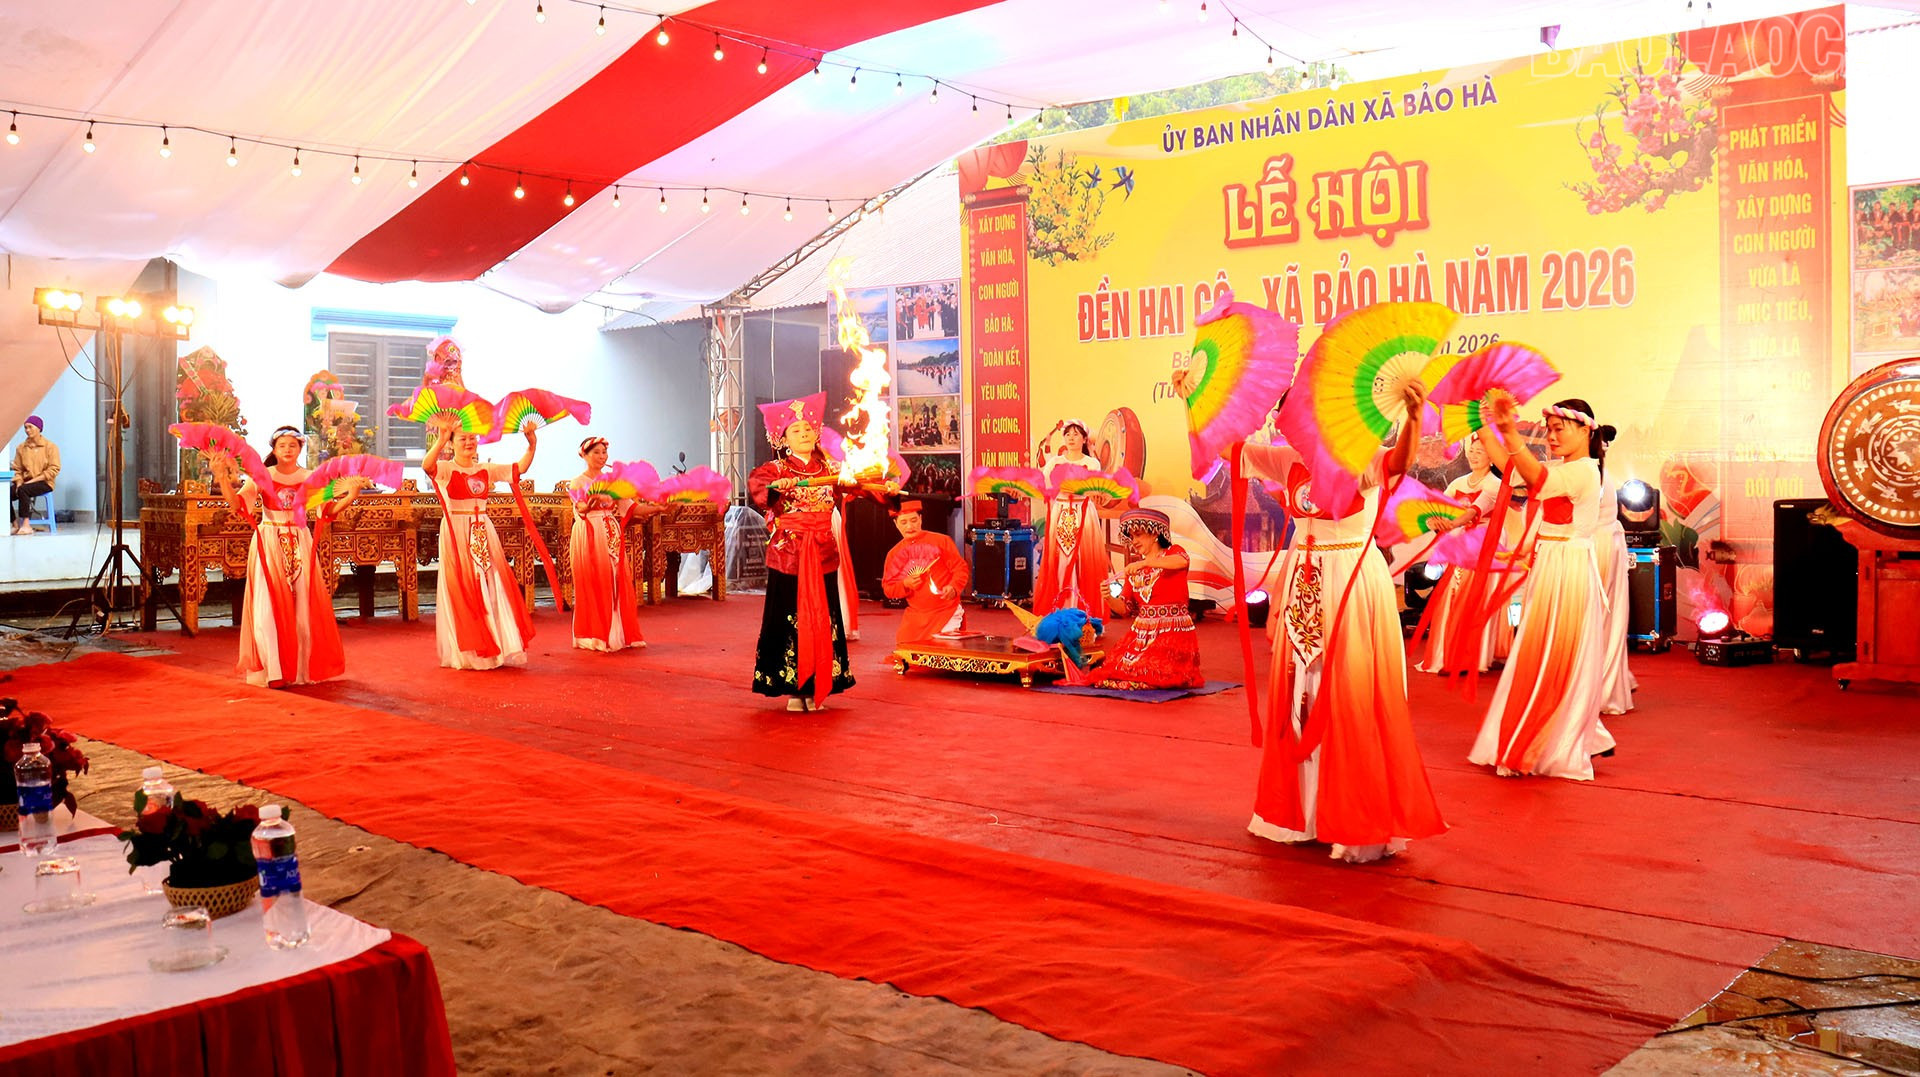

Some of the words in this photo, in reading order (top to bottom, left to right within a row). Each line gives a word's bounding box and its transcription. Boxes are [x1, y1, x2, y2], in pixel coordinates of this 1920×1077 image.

[1163, 124, 1186, 153] ỦY
[1193, 122, 1234, 149] BAN
[1241, 108, 1301, 143] NHÂN
[1308, 100, 1355, 131] DÂN
[1363, 91, 1396, 122] XÃ
[1403, 82, 1454, 116] BẢO
[1462, 75, 1497, 107] HÀ
[1730, 124, 1768, 150] PHÁT
[1772, 113, 1817, 146] TRIỂN
[1738, 160, 1768, 184] VĂN
[1773, 155, 1809, 181] HÓA,
[1223, 153, 1299, 249] LỄ
[1307, 151, 1430, 248] HỘI
[1736, 195, 1765, 220] XÂY
[1769, 193, 1812, 220] DỰNG
[979, 215, 993, 234] XÂY
[995, 213, 1016, 235] DỰNG
[1734, 233, 1764, 255] CON
[1769, 225, 1816, 252] NGƯỜI
[981, 248, 996, 267] VĂN
[997, 246, 1015, 266] HÓA,
[1748, 263, 1777, 288] VỪA
[1781, 261, 1800, 286] LÀ
[978, 284, 994, 300] CON
[996, 278, 1019, 299] NGƯỜI
[1078, 276, 1130, 341] ĐỀN
[1139, 285, 1184, 337] HAI
[1262, 264, 1304, 326] XÃ
[1313, 253, 1378, 325] BẢO
[1389, 252, 1433, 303] HÀ
[1445, 246, 1529, 314] NĂM
[1541, 247, 1635, 311] 2026
[984, 313, 999, 333] BẢO
[1001, 313, 1014, 332] HÀ:
[1737, 303, 1771, 327] MỤC
[1776, 297, 1813, 323] TIÊU,
[1005, 345, 1021, 366] KẾT,
[1172, 350, 1192, 368] Bả
[981, 382, 995, 400] YÊU
[997, 381, 1020, 400] NƯỚC,
[981, 414, 991, 434] KỶ
[992, 417, 1020, 435] CƯƠNG,
[981, 449, 996, 467] VĂN
[1775, 473, 1804, 497] MỚI
